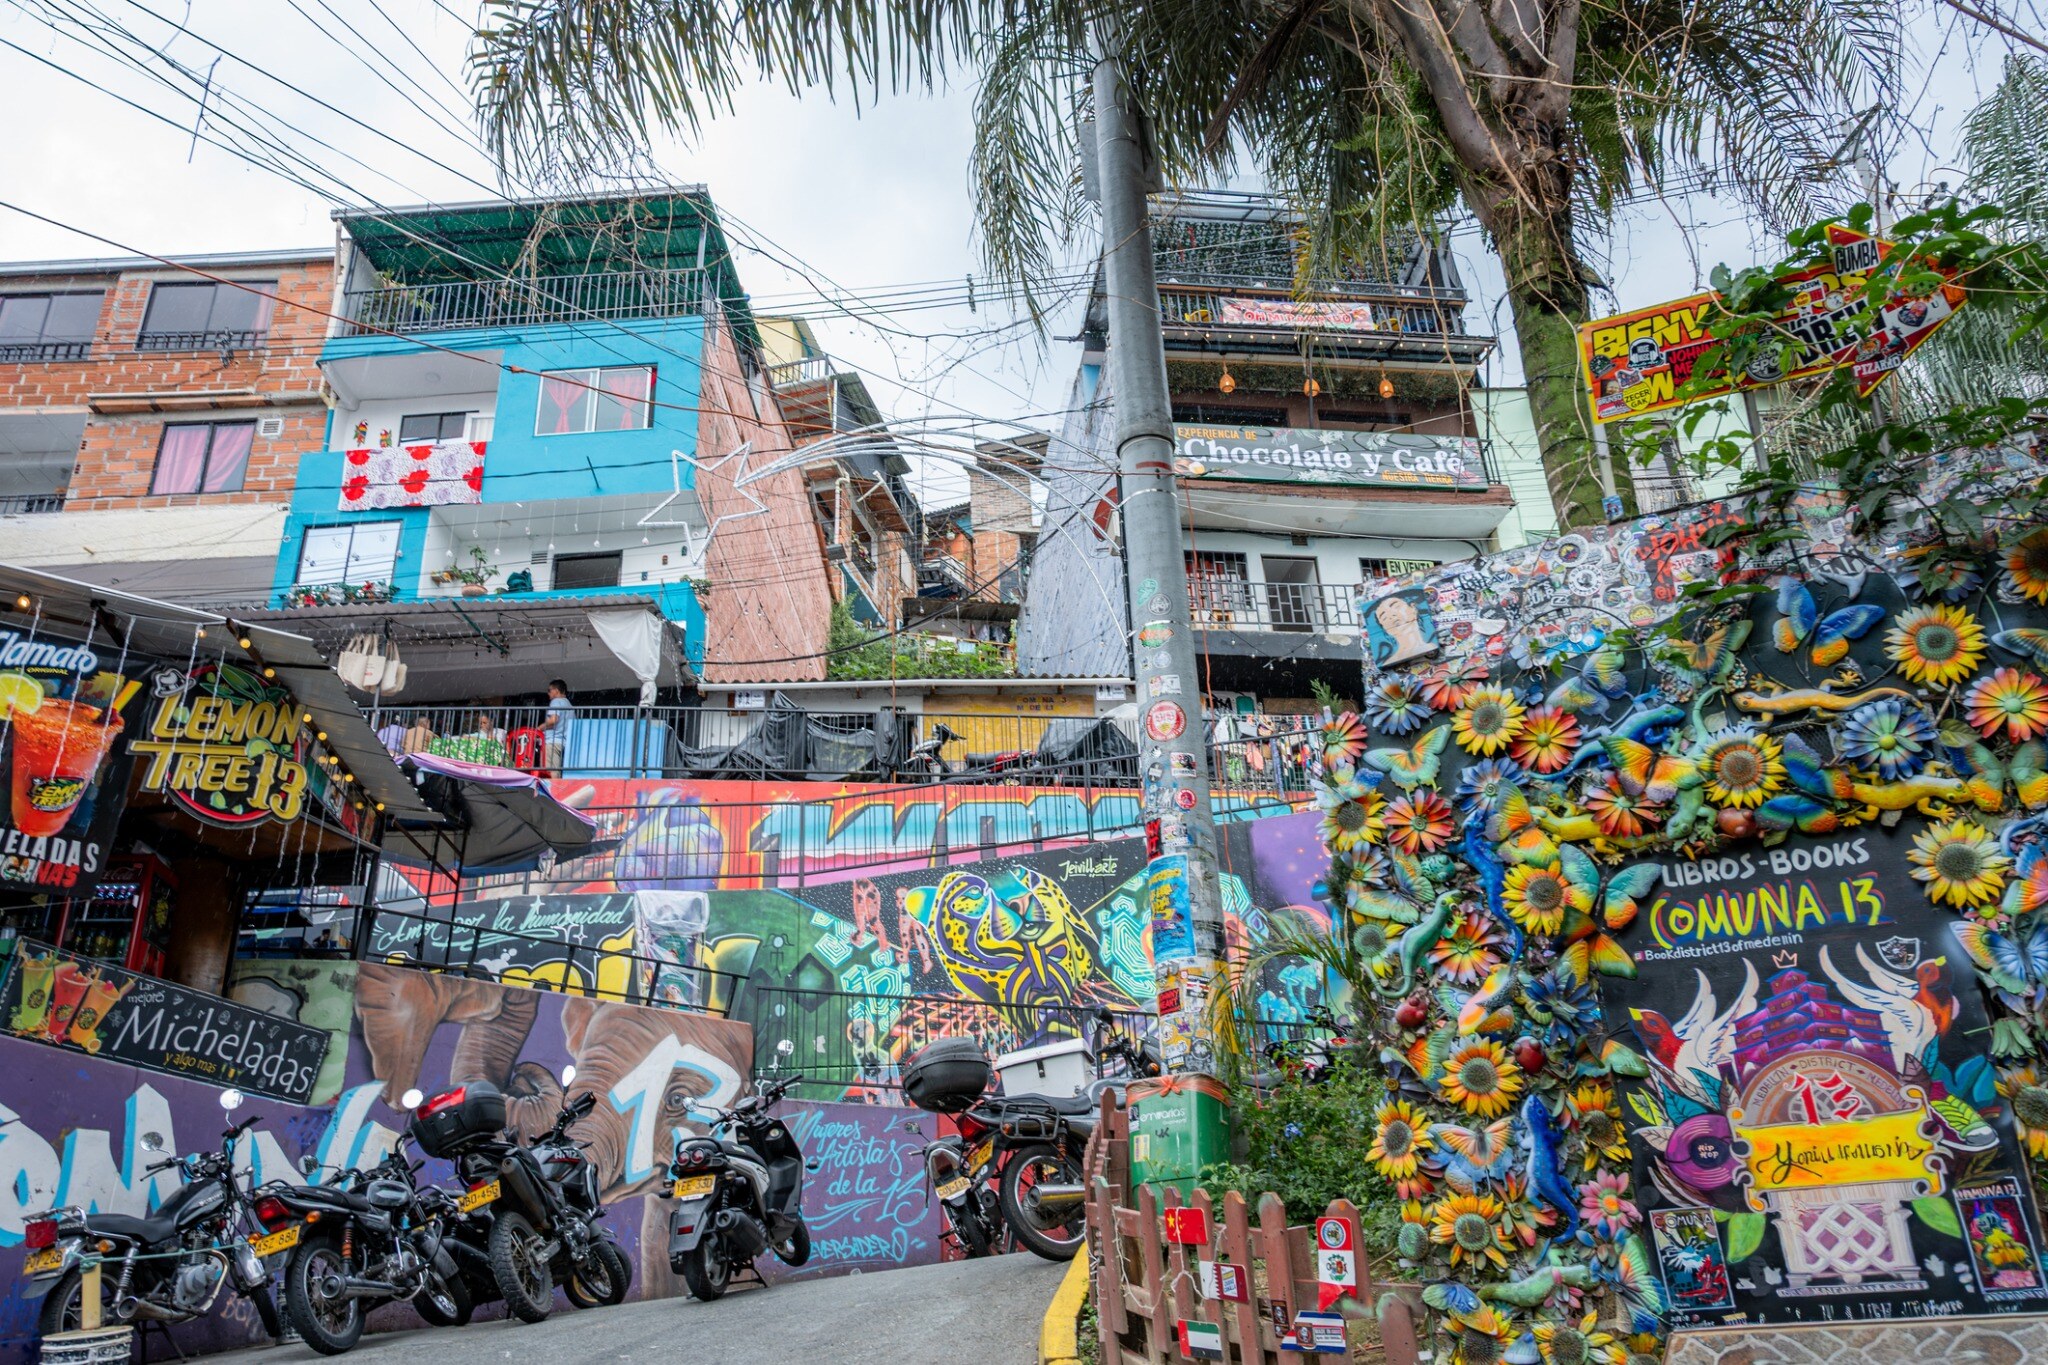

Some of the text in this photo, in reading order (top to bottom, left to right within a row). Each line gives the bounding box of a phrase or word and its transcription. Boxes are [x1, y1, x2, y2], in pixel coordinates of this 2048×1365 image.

[1835, 239, 1880, 275] GUMBA
[1624, 388, 1650, 402] ZECER
[1631, 397, 1648, 409] GAK
[1177, 427, 1257, 440] EXPERIENCIA DE
[1184, 438, 1465, 477] Chocolate y Café
[1389, 560, 1433, 575] EN VENTA
[151, 693, 305, 744] LEMON
[129, 740, 308, 820] TREE 13
[1650, 871, 1886, 949] COMUNA 13
[139, 982, 155, 990] Las
[112, 1005, 313, 1094] Micheladas
[172, 1050, 197, 1072] algo
[1800, 1056, 1856, 1070] DISTRICT
[828, 1170, 850, 1195] de
[855, 1168, 880, 1195] la
